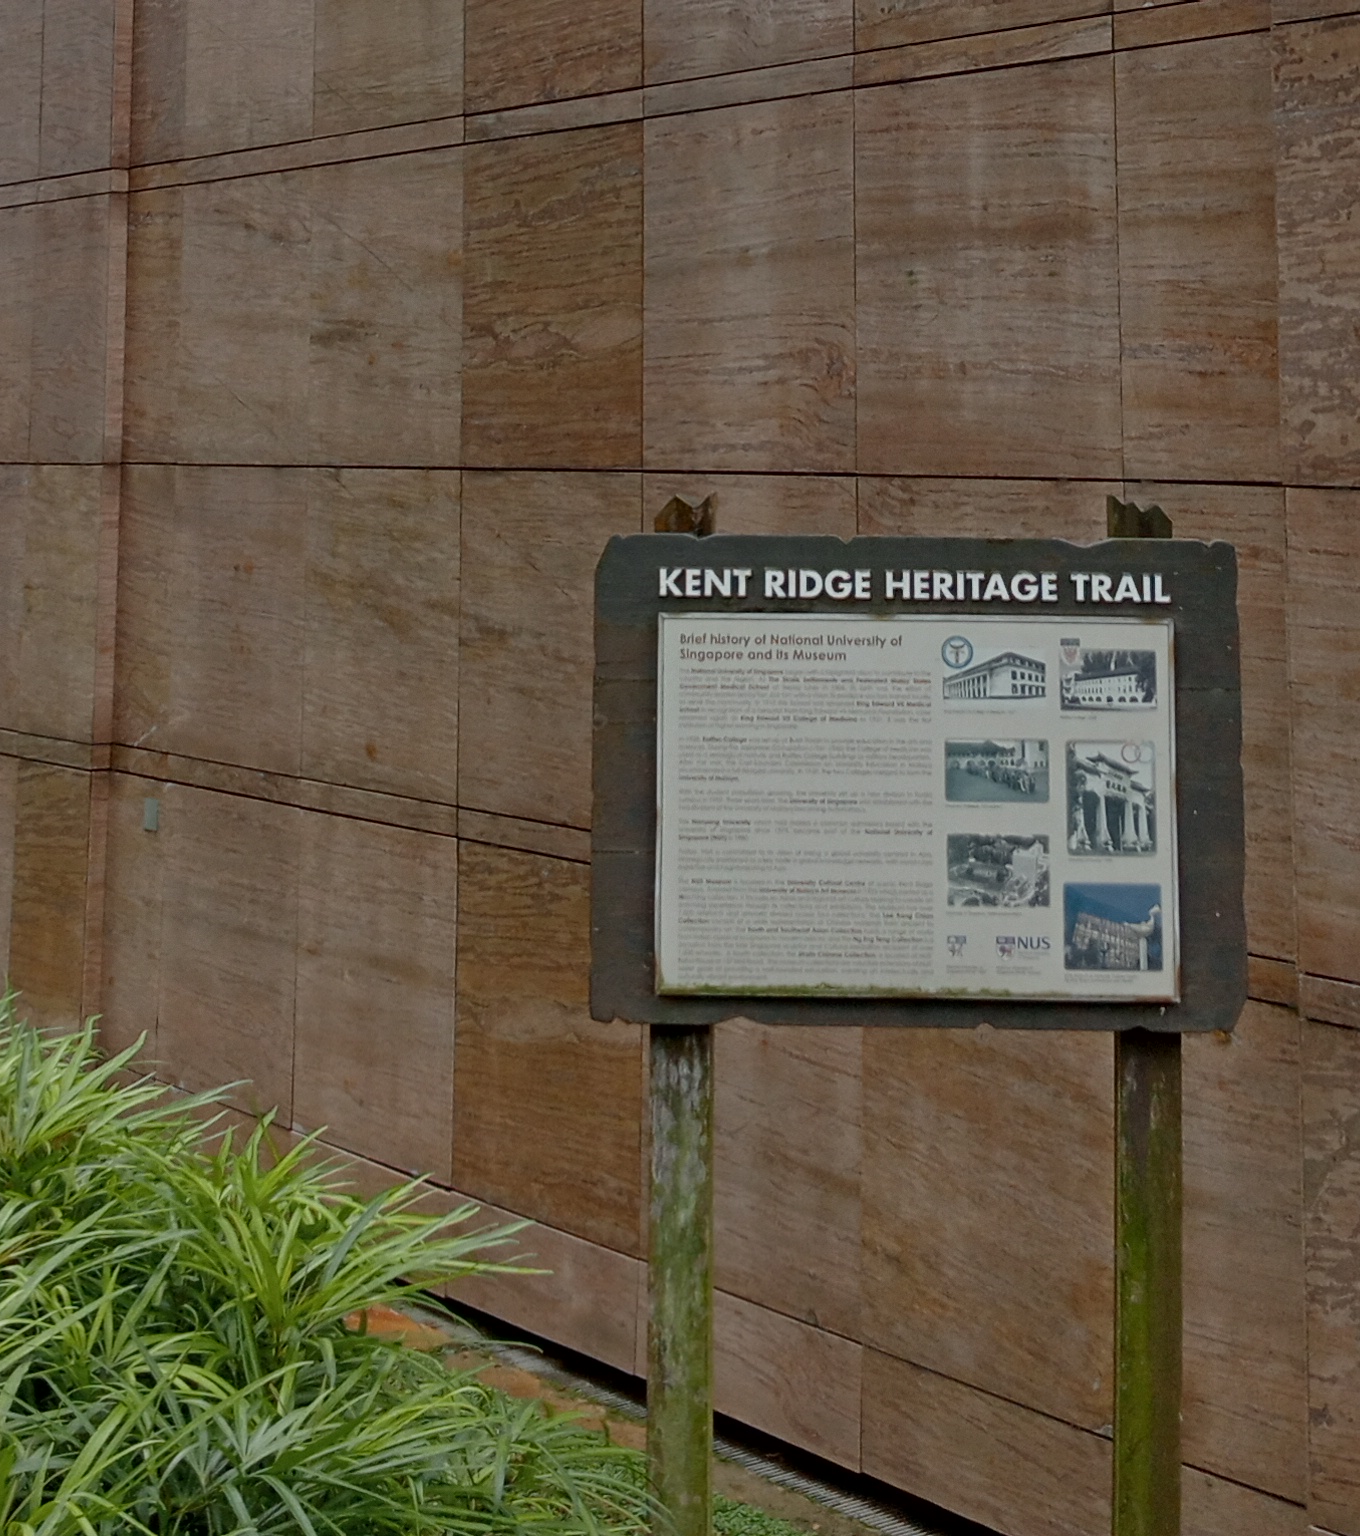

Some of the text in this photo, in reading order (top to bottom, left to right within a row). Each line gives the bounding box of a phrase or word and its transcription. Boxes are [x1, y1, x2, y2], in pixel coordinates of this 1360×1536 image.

[658, 567, 1172, 604] KENT RIDGE HERITAGE TRAIL
[680, 632, 903, 648] Brief history of National University of
[680, 648, 847, 662] Singapore and its Museum
[1017, 936, 1051, 950] NUS
